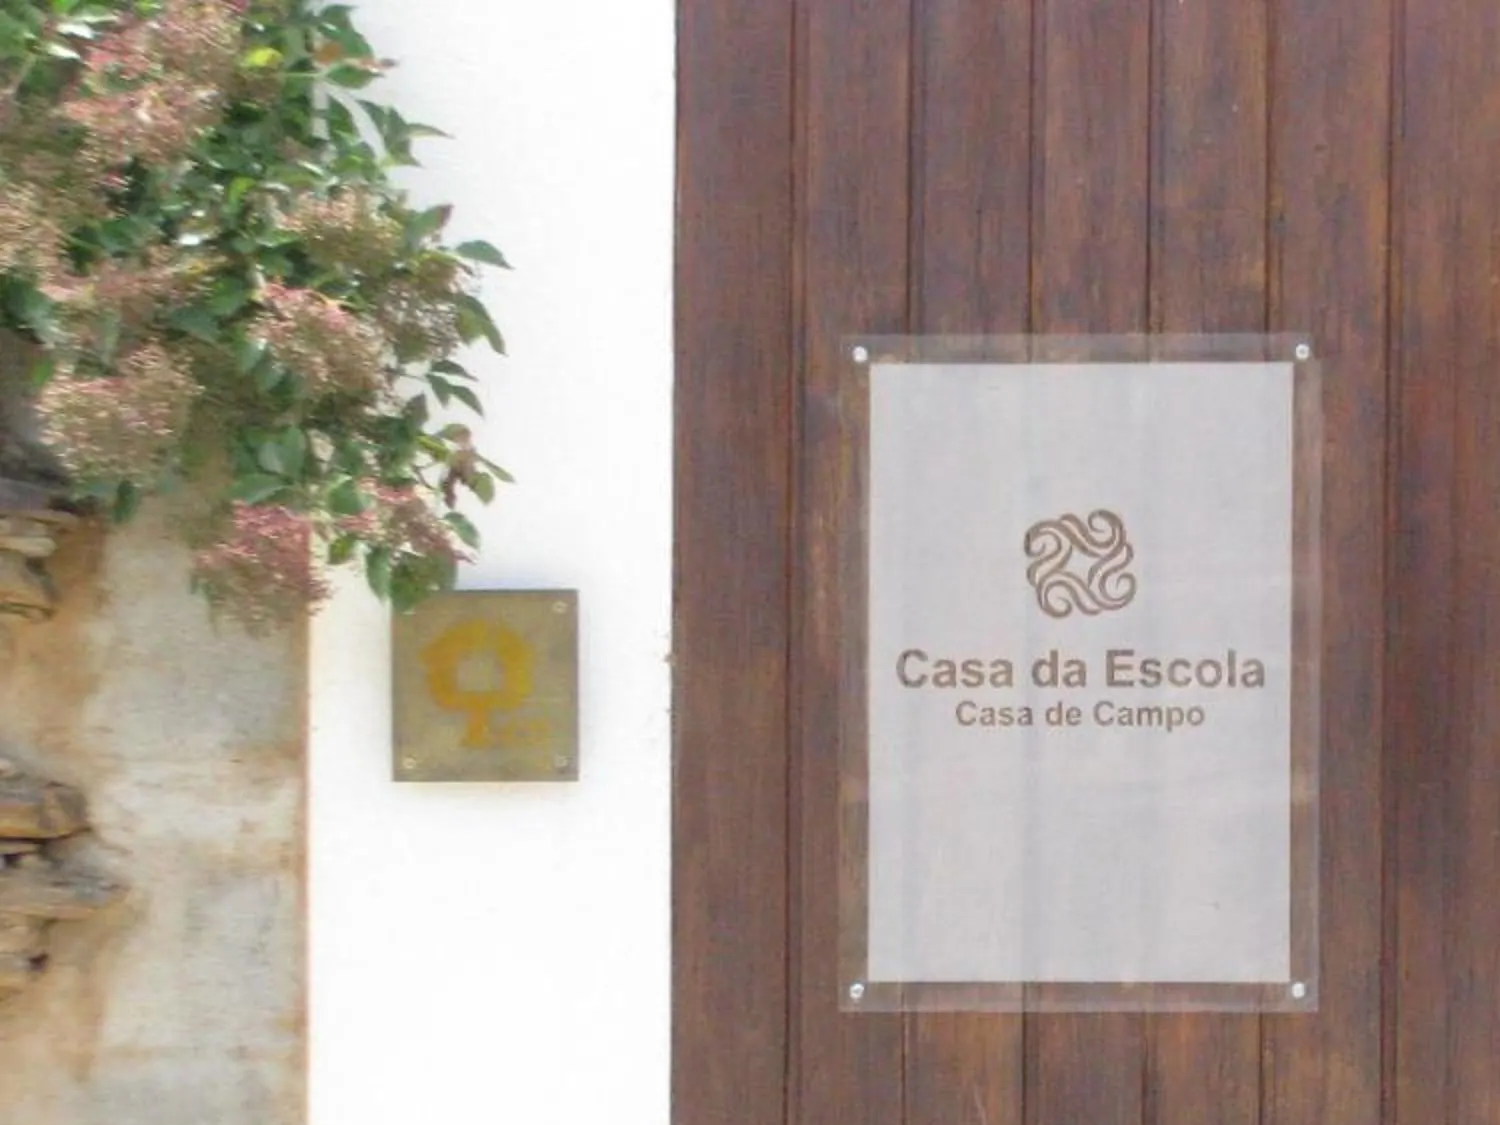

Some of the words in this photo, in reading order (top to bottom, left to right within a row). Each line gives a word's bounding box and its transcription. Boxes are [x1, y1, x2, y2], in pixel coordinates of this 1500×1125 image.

[896, 648, 1013, 689] Casa
[1031, 649, 1087, 689] da
[1105, 649, 1265, 689] Escola
[955, 700, 1034, 727] Casa
[1045, 700, 1082, 727] de
[1093, 700, 1205, 733] Campo
